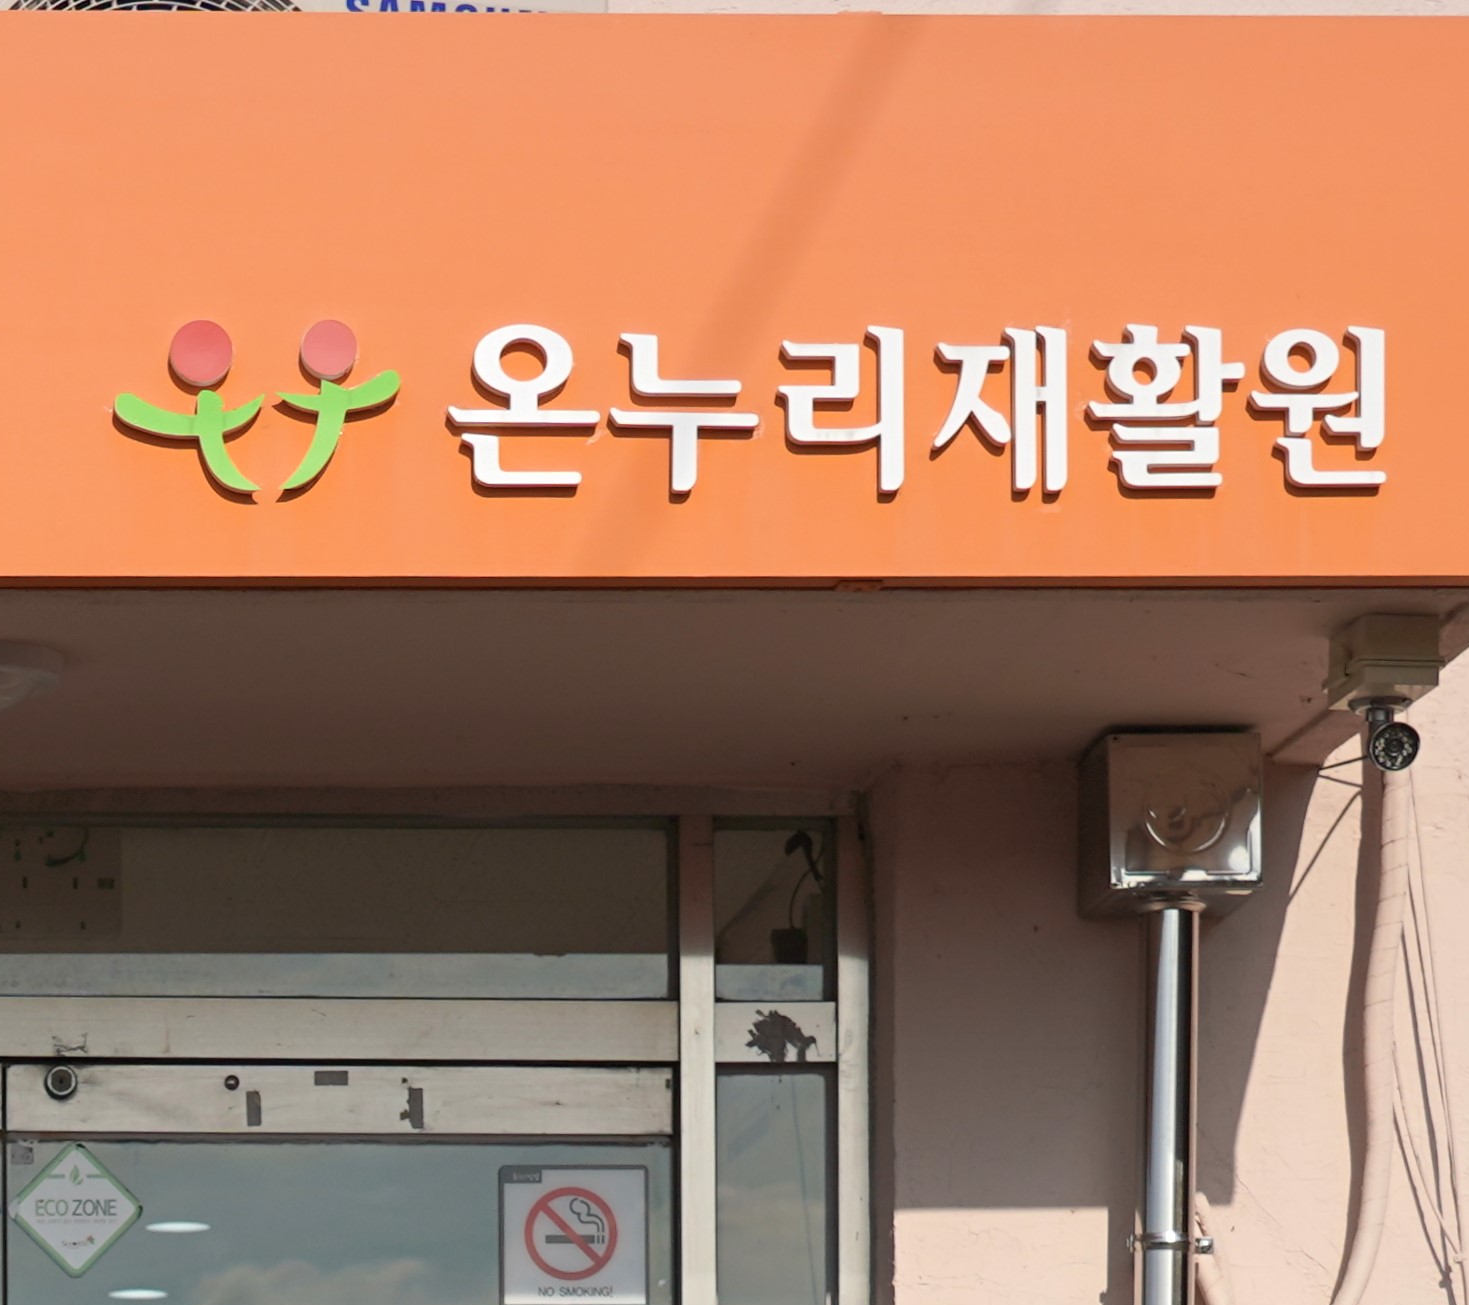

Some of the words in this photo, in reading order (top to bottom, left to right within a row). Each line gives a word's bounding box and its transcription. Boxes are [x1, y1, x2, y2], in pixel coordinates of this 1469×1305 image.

[445, 321, 1388, 498] 온누리재활원
[35, 1199, 68, 1217] ECO
[72, 1199, 117, 1217] ZONE
[538, 1286, 555, 1297] NO
[559, 1286, 614, 1298] SMOKING!
